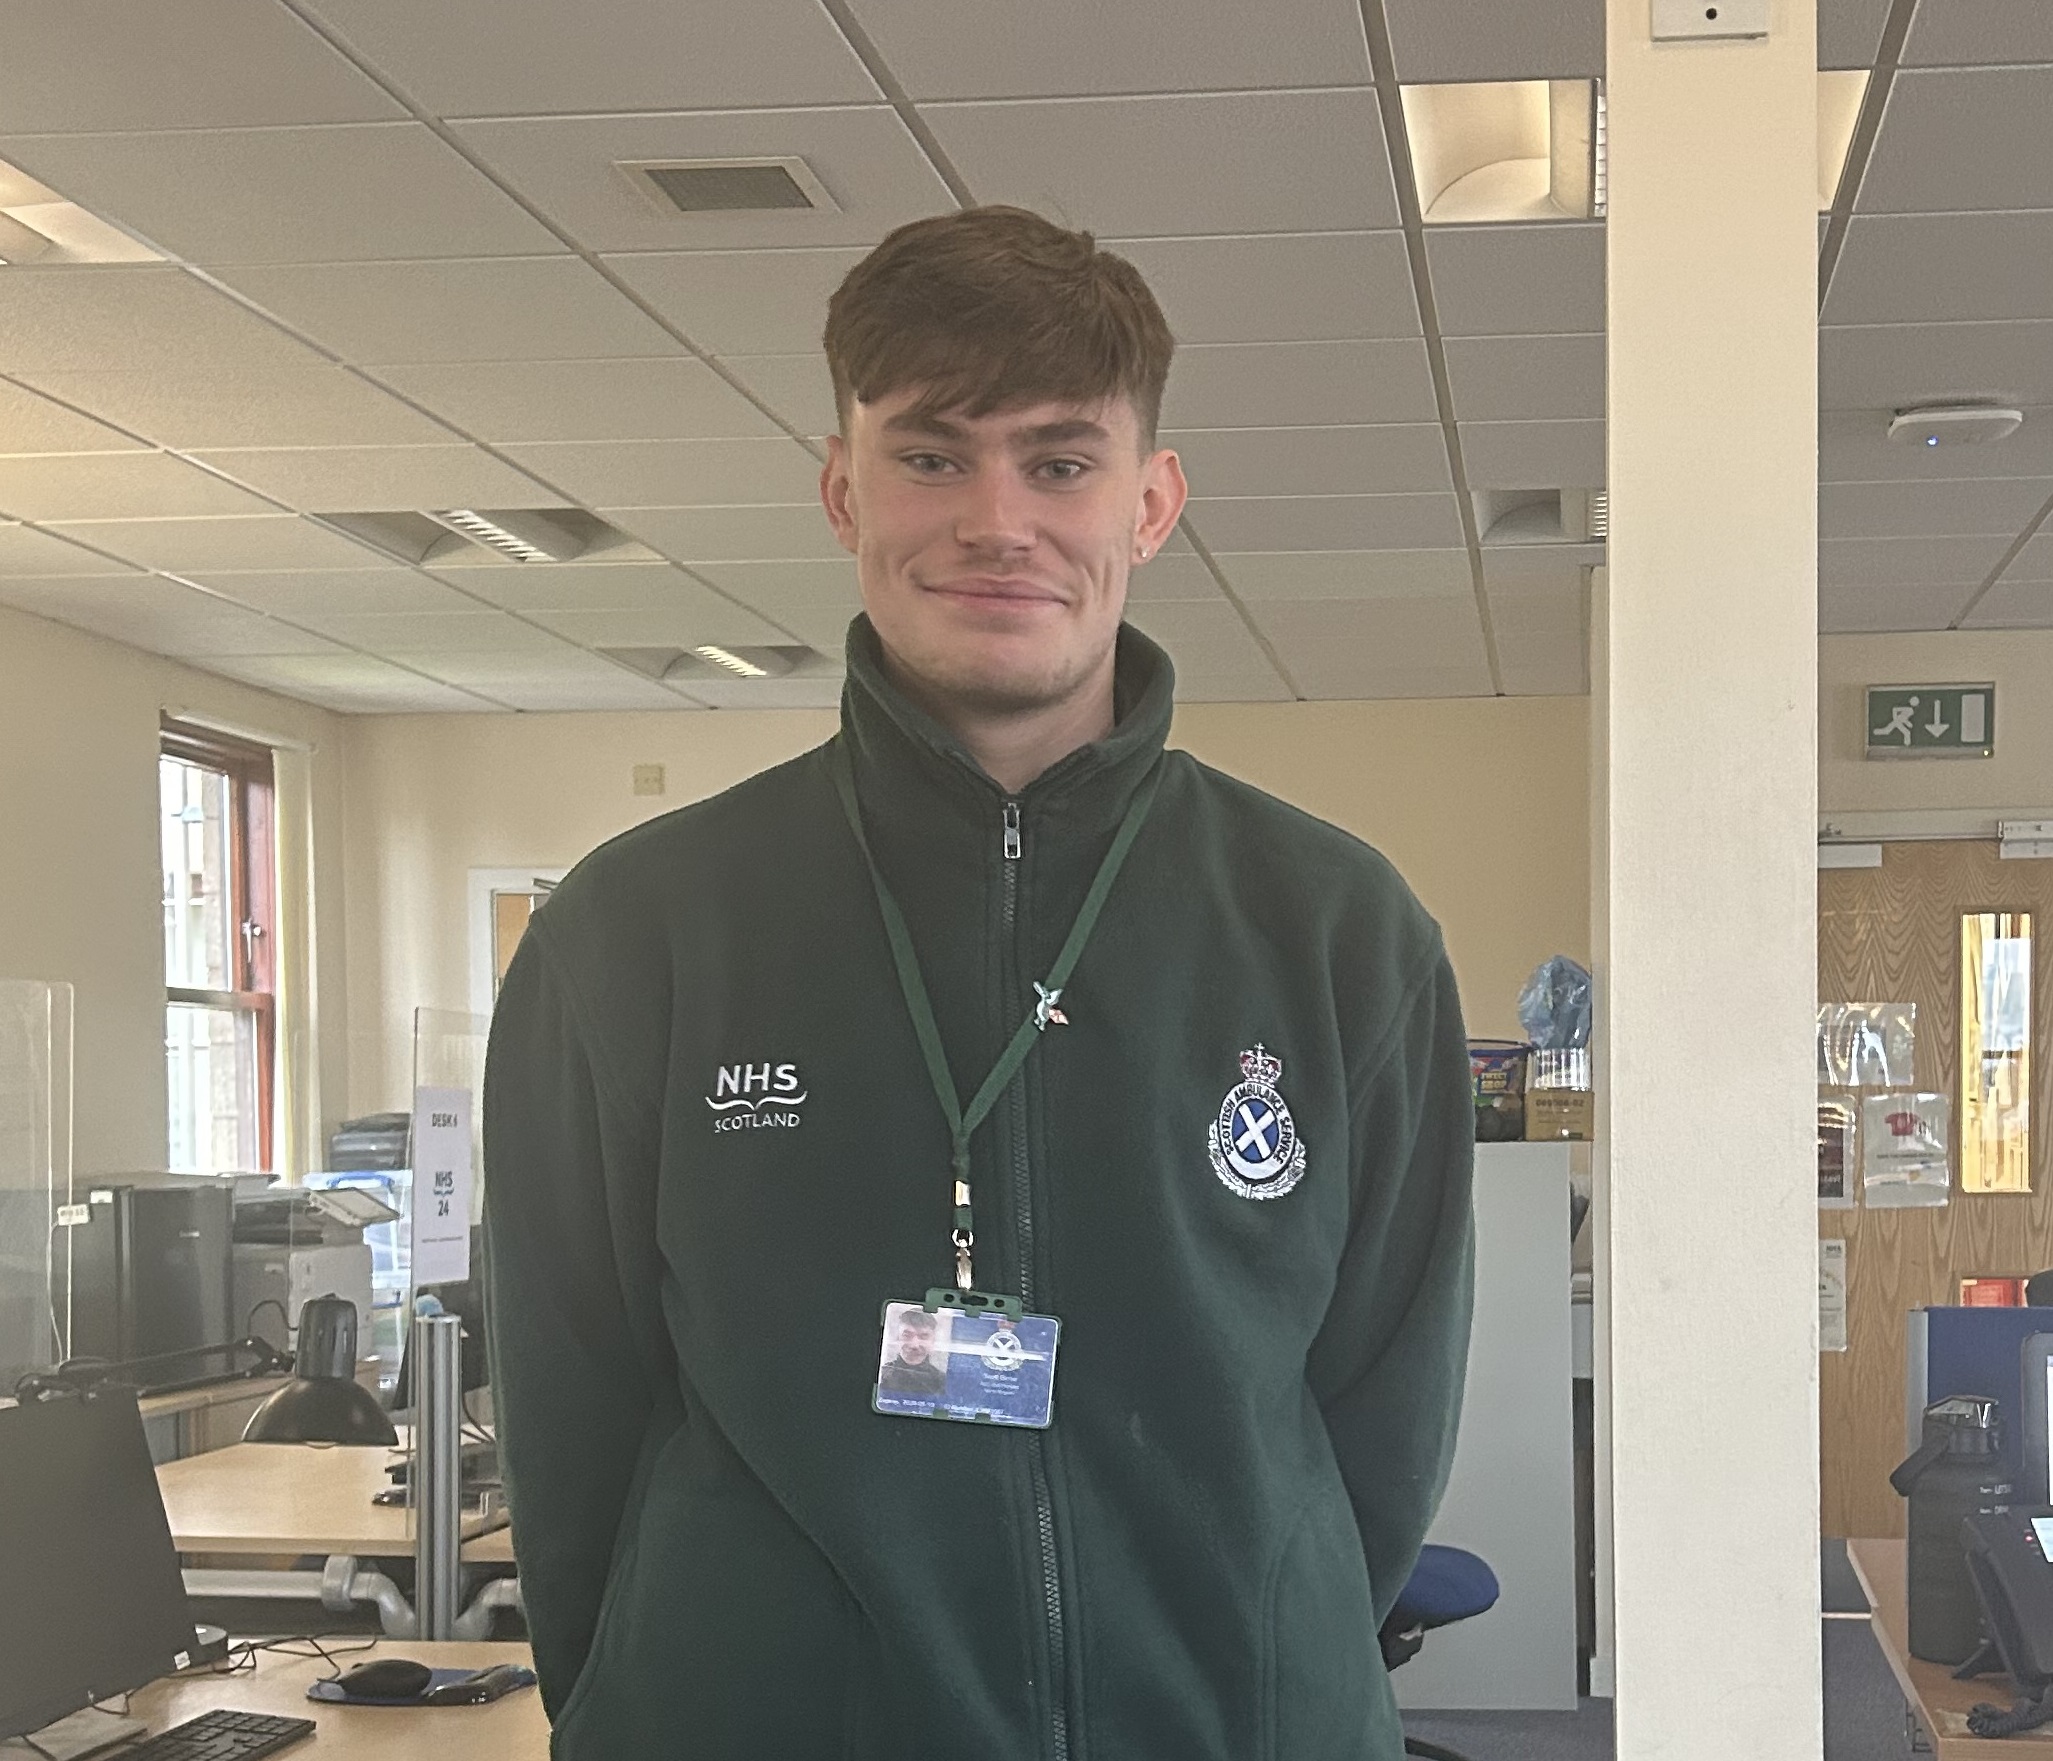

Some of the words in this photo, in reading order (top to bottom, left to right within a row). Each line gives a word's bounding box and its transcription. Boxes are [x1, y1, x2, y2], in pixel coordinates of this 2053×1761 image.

[716, 1062, 798, 1097] NHS
[714, 1112, 800, 1134] SCOTLAND
[1219, 1099, 1236, 1156] SCOTTISH
[1234, 1083, 1283, 1115] AMBULANCE
[1272, 1115, 1292, 1165] SERVICE
[435, 1171, 452, 1188] NHS
[438, 1200, 450, 1216] 24
